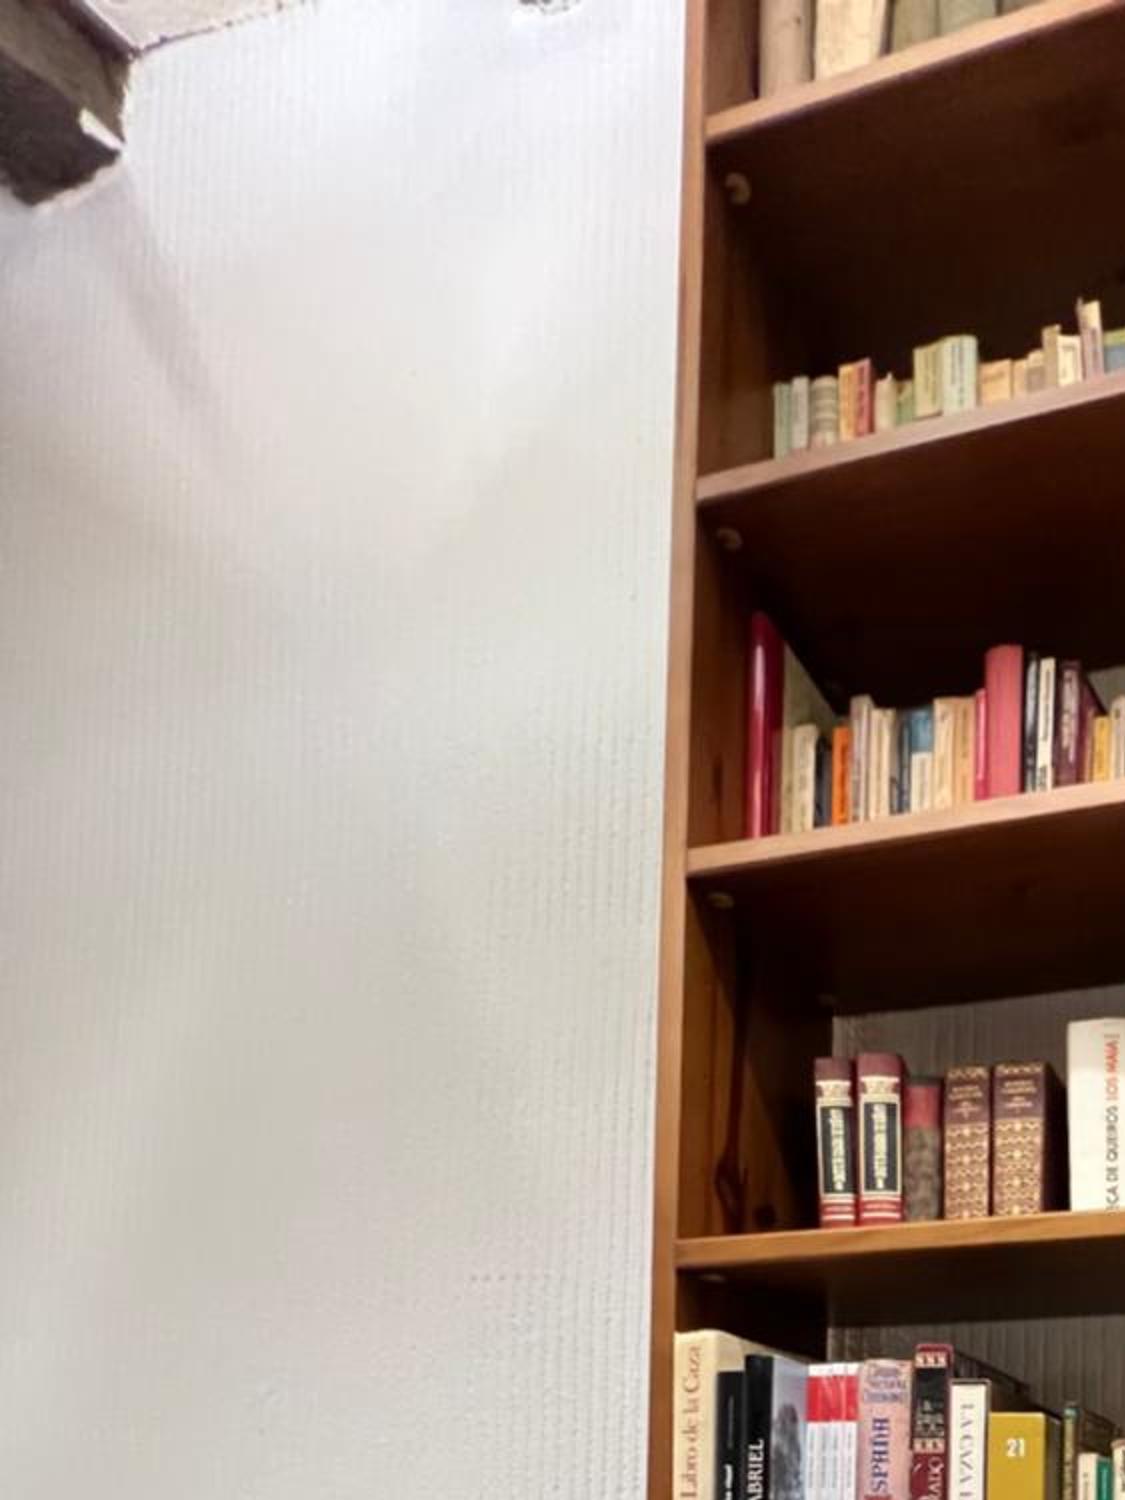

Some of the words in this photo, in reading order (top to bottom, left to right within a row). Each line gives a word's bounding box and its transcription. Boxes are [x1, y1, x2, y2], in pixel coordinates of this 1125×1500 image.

[1104, 1164, 1119, 1182] DE
[682, 1344, 703, 1394] Caza
[682, 1396, 702, 1414] la
[960, 1403, 975, 1429] LA
[682, 1423, 701, 1443] de
[959, 1433, 975, 1483] CAZA
[1006, 1437, 1025, 1457] 21
[681, 1445, 700, 1499] Libro
